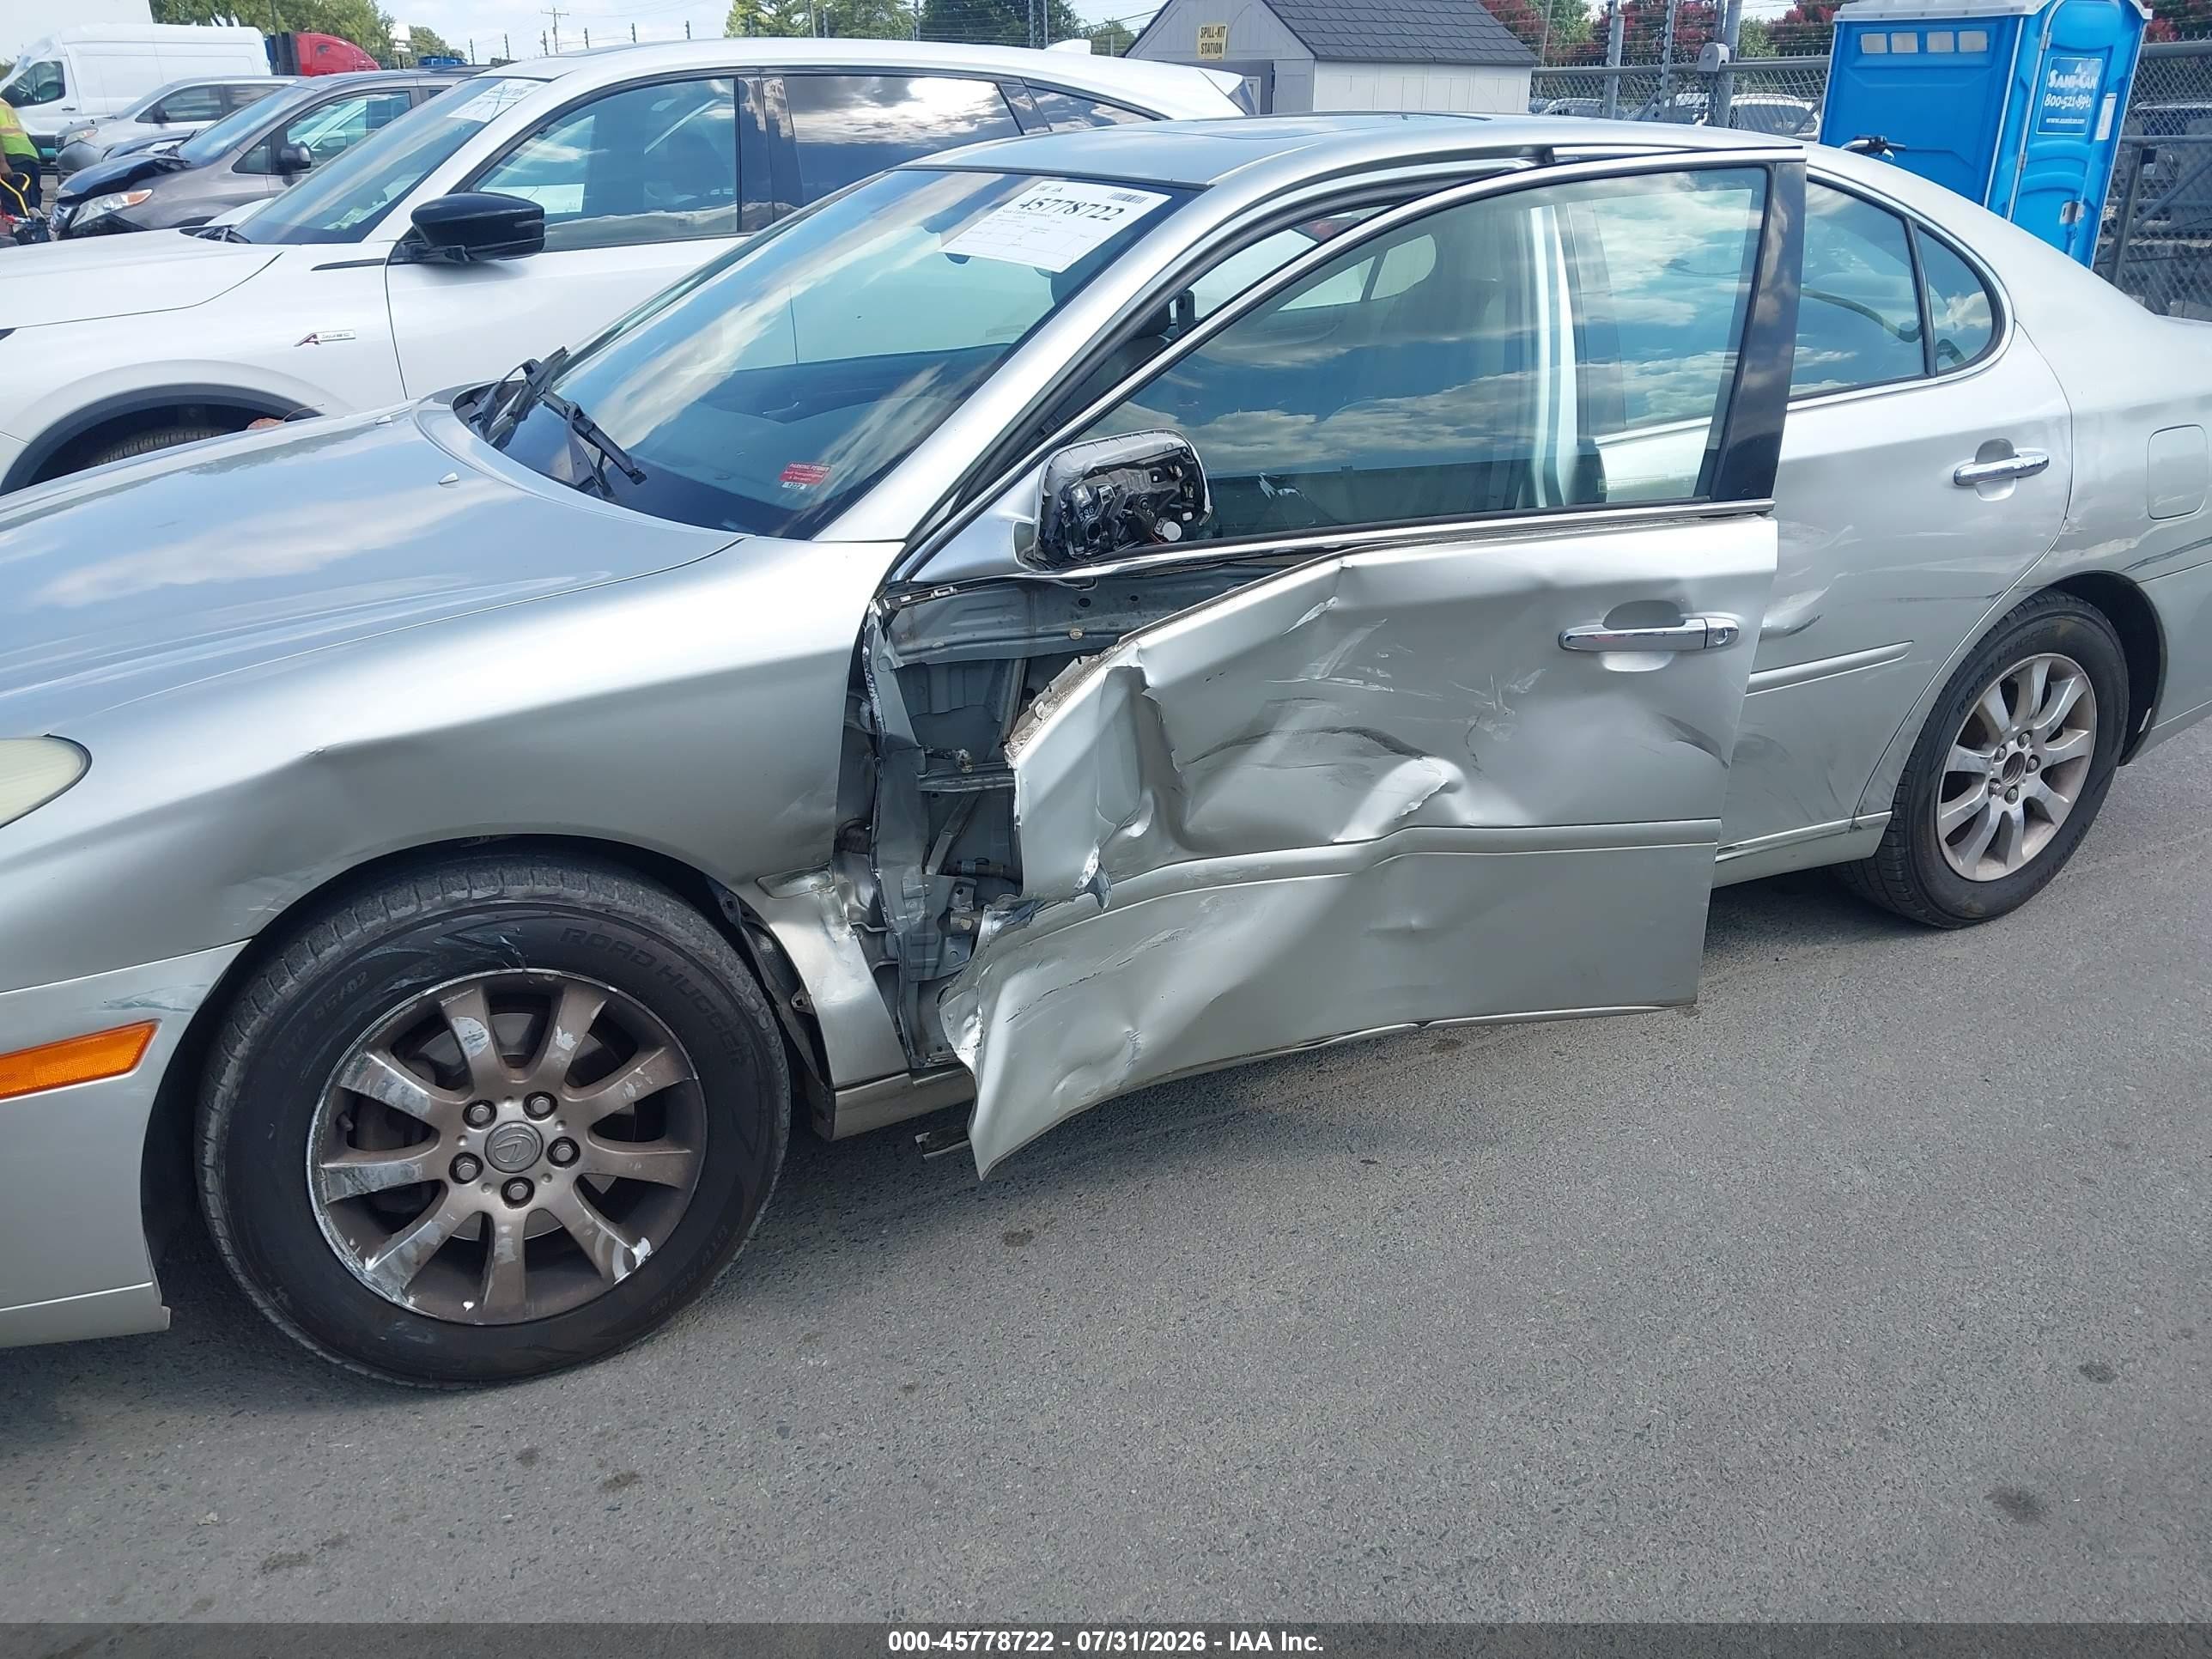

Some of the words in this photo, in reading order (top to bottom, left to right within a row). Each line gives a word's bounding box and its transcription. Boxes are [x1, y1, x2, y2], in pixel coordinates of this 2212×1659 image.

[1200, 27, 1225, 39] SPILL-KIT
[1201, 42, 1222, 54] STATION
[1019, 197, 1125, 221] 45778722
[560, 927, 657, 969] ROAD
